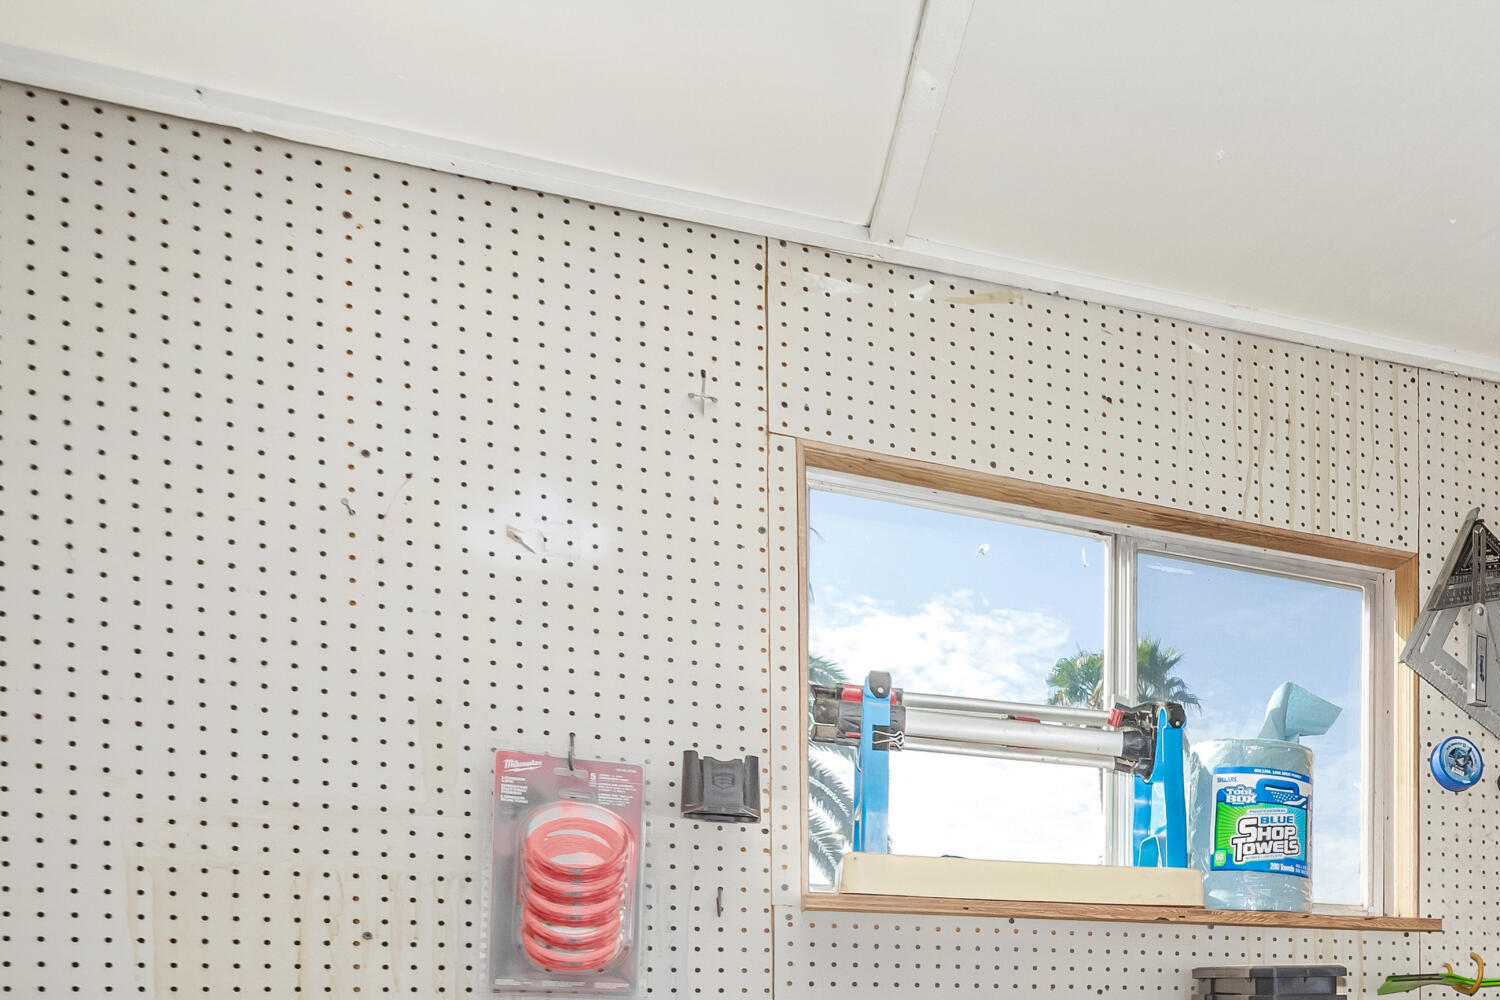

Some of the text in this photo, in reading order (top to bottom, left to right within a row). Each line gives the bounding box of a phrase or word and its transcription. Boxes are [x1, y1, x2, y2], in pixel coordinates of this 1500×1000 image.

[1225, 787, 1254, 796] TOOL
[1226, 794, 1257, 804] BOX
[1260, 815, 1294, 825] BLUE
[1238, 816, 1297, 842] SHOP
[1231, 836, 1300, 863] TOWELS
